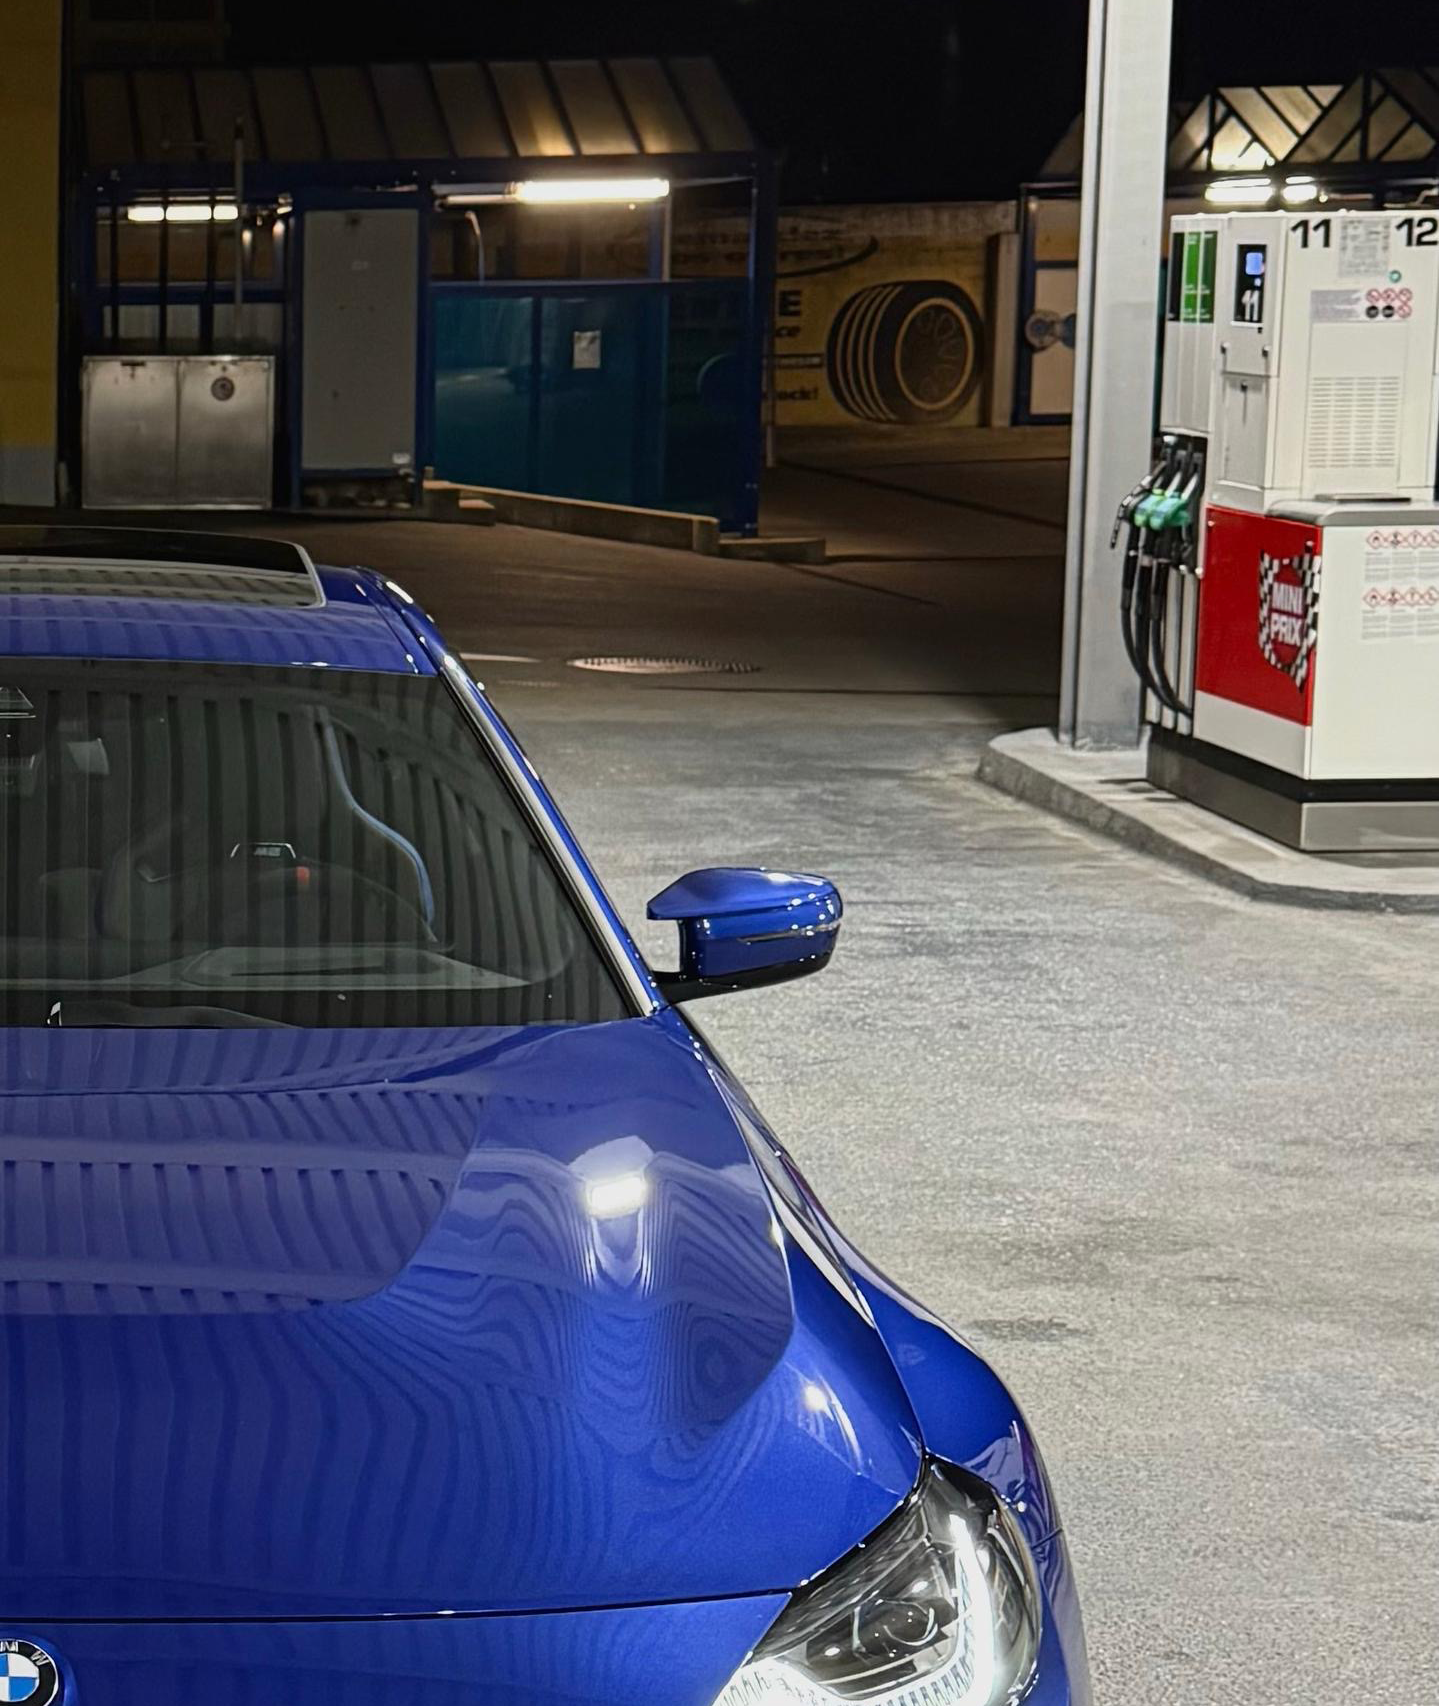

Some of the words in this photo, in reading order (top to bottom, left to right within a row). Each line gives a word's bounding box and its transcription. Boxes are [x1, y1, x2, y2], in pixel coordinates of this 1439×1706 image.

[1290, 218, 1332, 248] 11
[1395, 216, 1439, 247] 12
[1241, 289, 1260, 321] 11
[1271, 581, 1303, 615] MINI
[1270, 612, 1301, 646] PRIX
